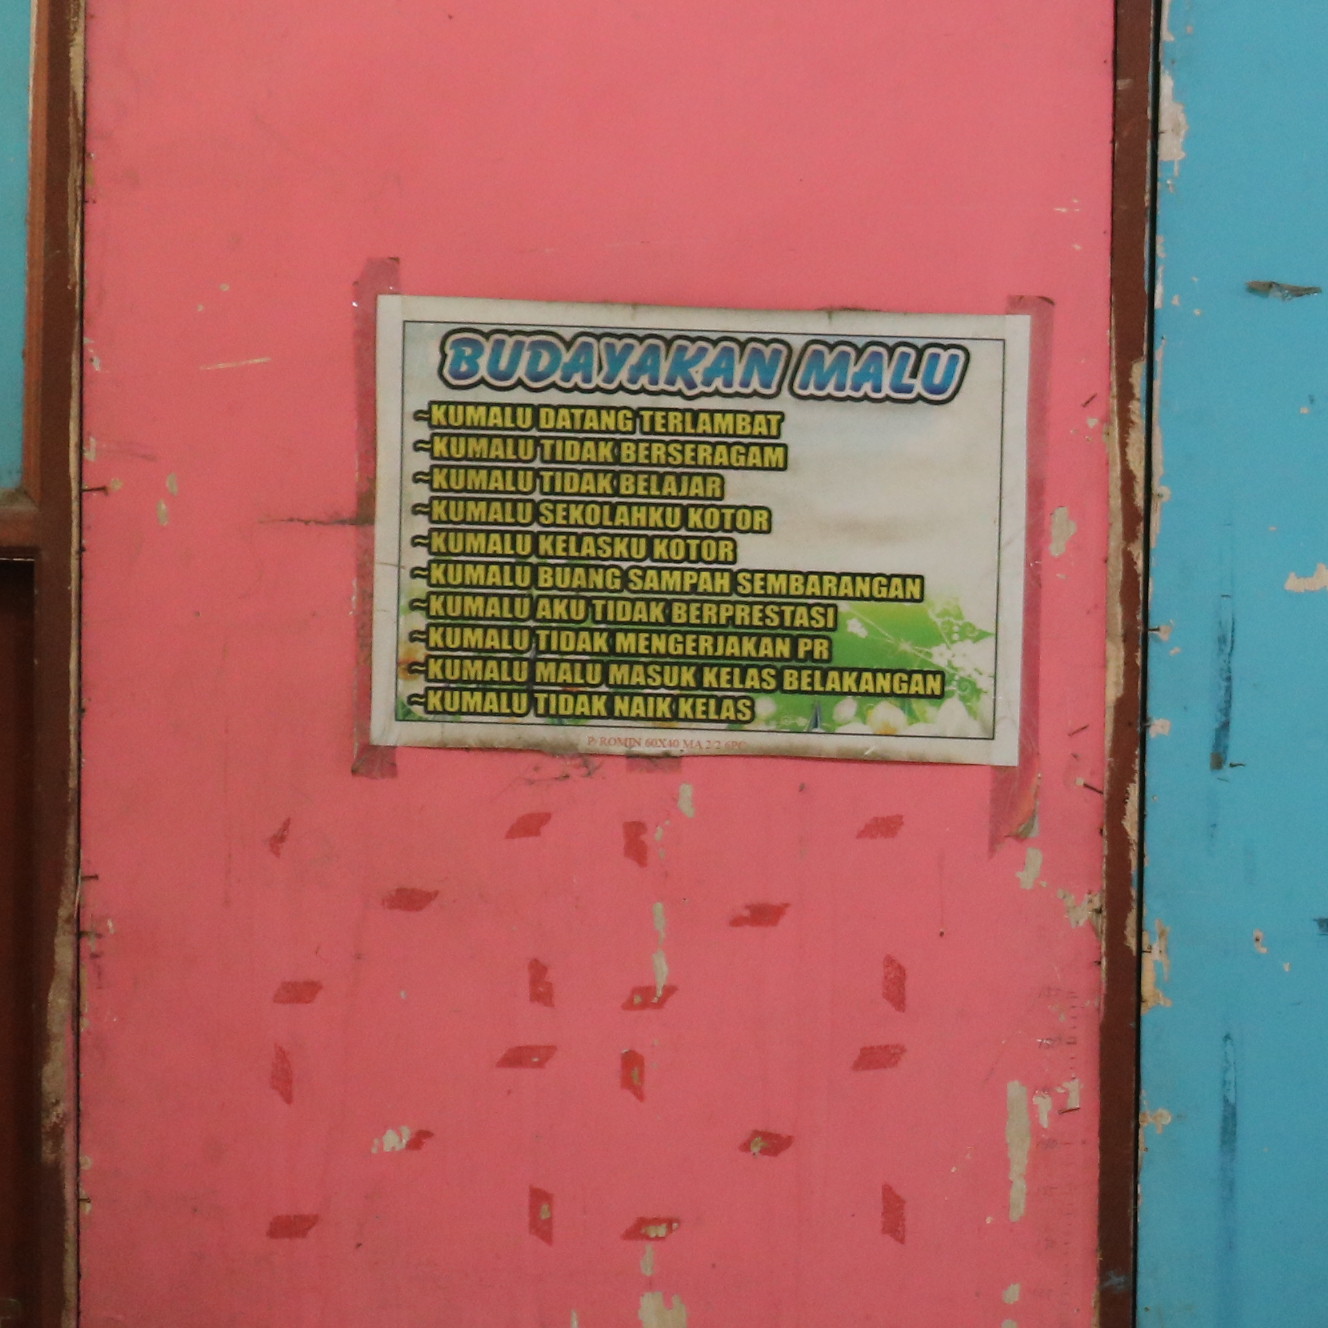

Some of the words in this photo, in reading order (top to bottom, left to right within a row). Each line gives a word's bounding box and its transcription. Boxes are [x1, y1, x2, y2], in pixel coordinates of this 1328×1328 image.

[443, 331, 788, 397] BUDAYAKAN
[792, 341, 967, 401] MALU
[537, 405, 635, 434] DATANG
[638, 408, 784, 437] TERLAMBAT
[538, 438, 616, 465] TIDAK
[618, 441, 786, 470] BERSERAGAM
[538, 469, 615, 496] TIDAK
[617, 472, 724, 499] BELAJAR
[537, 501, 683, 530] SEKOLAHKU
[686, 505, 771, 533] KOTOR
[536, 532, 648, 561] KELASKU
[651, 537, 736, 564] KOTOR
[536, 564, 623, 591] BUANG
[625, 567, 732, 595] SAMPAH
[735, 570, 923, 601] SEMBARANGAN
[534, 597, 588, 622] AKU
[590, 598, 668, 625] TIDAK
[670, 600, 837, 631] BERPRESTASI
[534, 628, 611, 655] TIDAK
[613, 631, 793, 659] MENGERJAKAN
[796, 636, 831, 662] PR
[534, 659, 604, 687] MALU
[607, 662, 698, 689] MASUK
[701, 665, 778, 692] KELAS
[781, 667, 944, 698] BELAKANGAN
[532, 691, 609, 718] TIDAK
[612, 693, 674, 720] NAIK
[677, 695, 754, 723] KELAS
